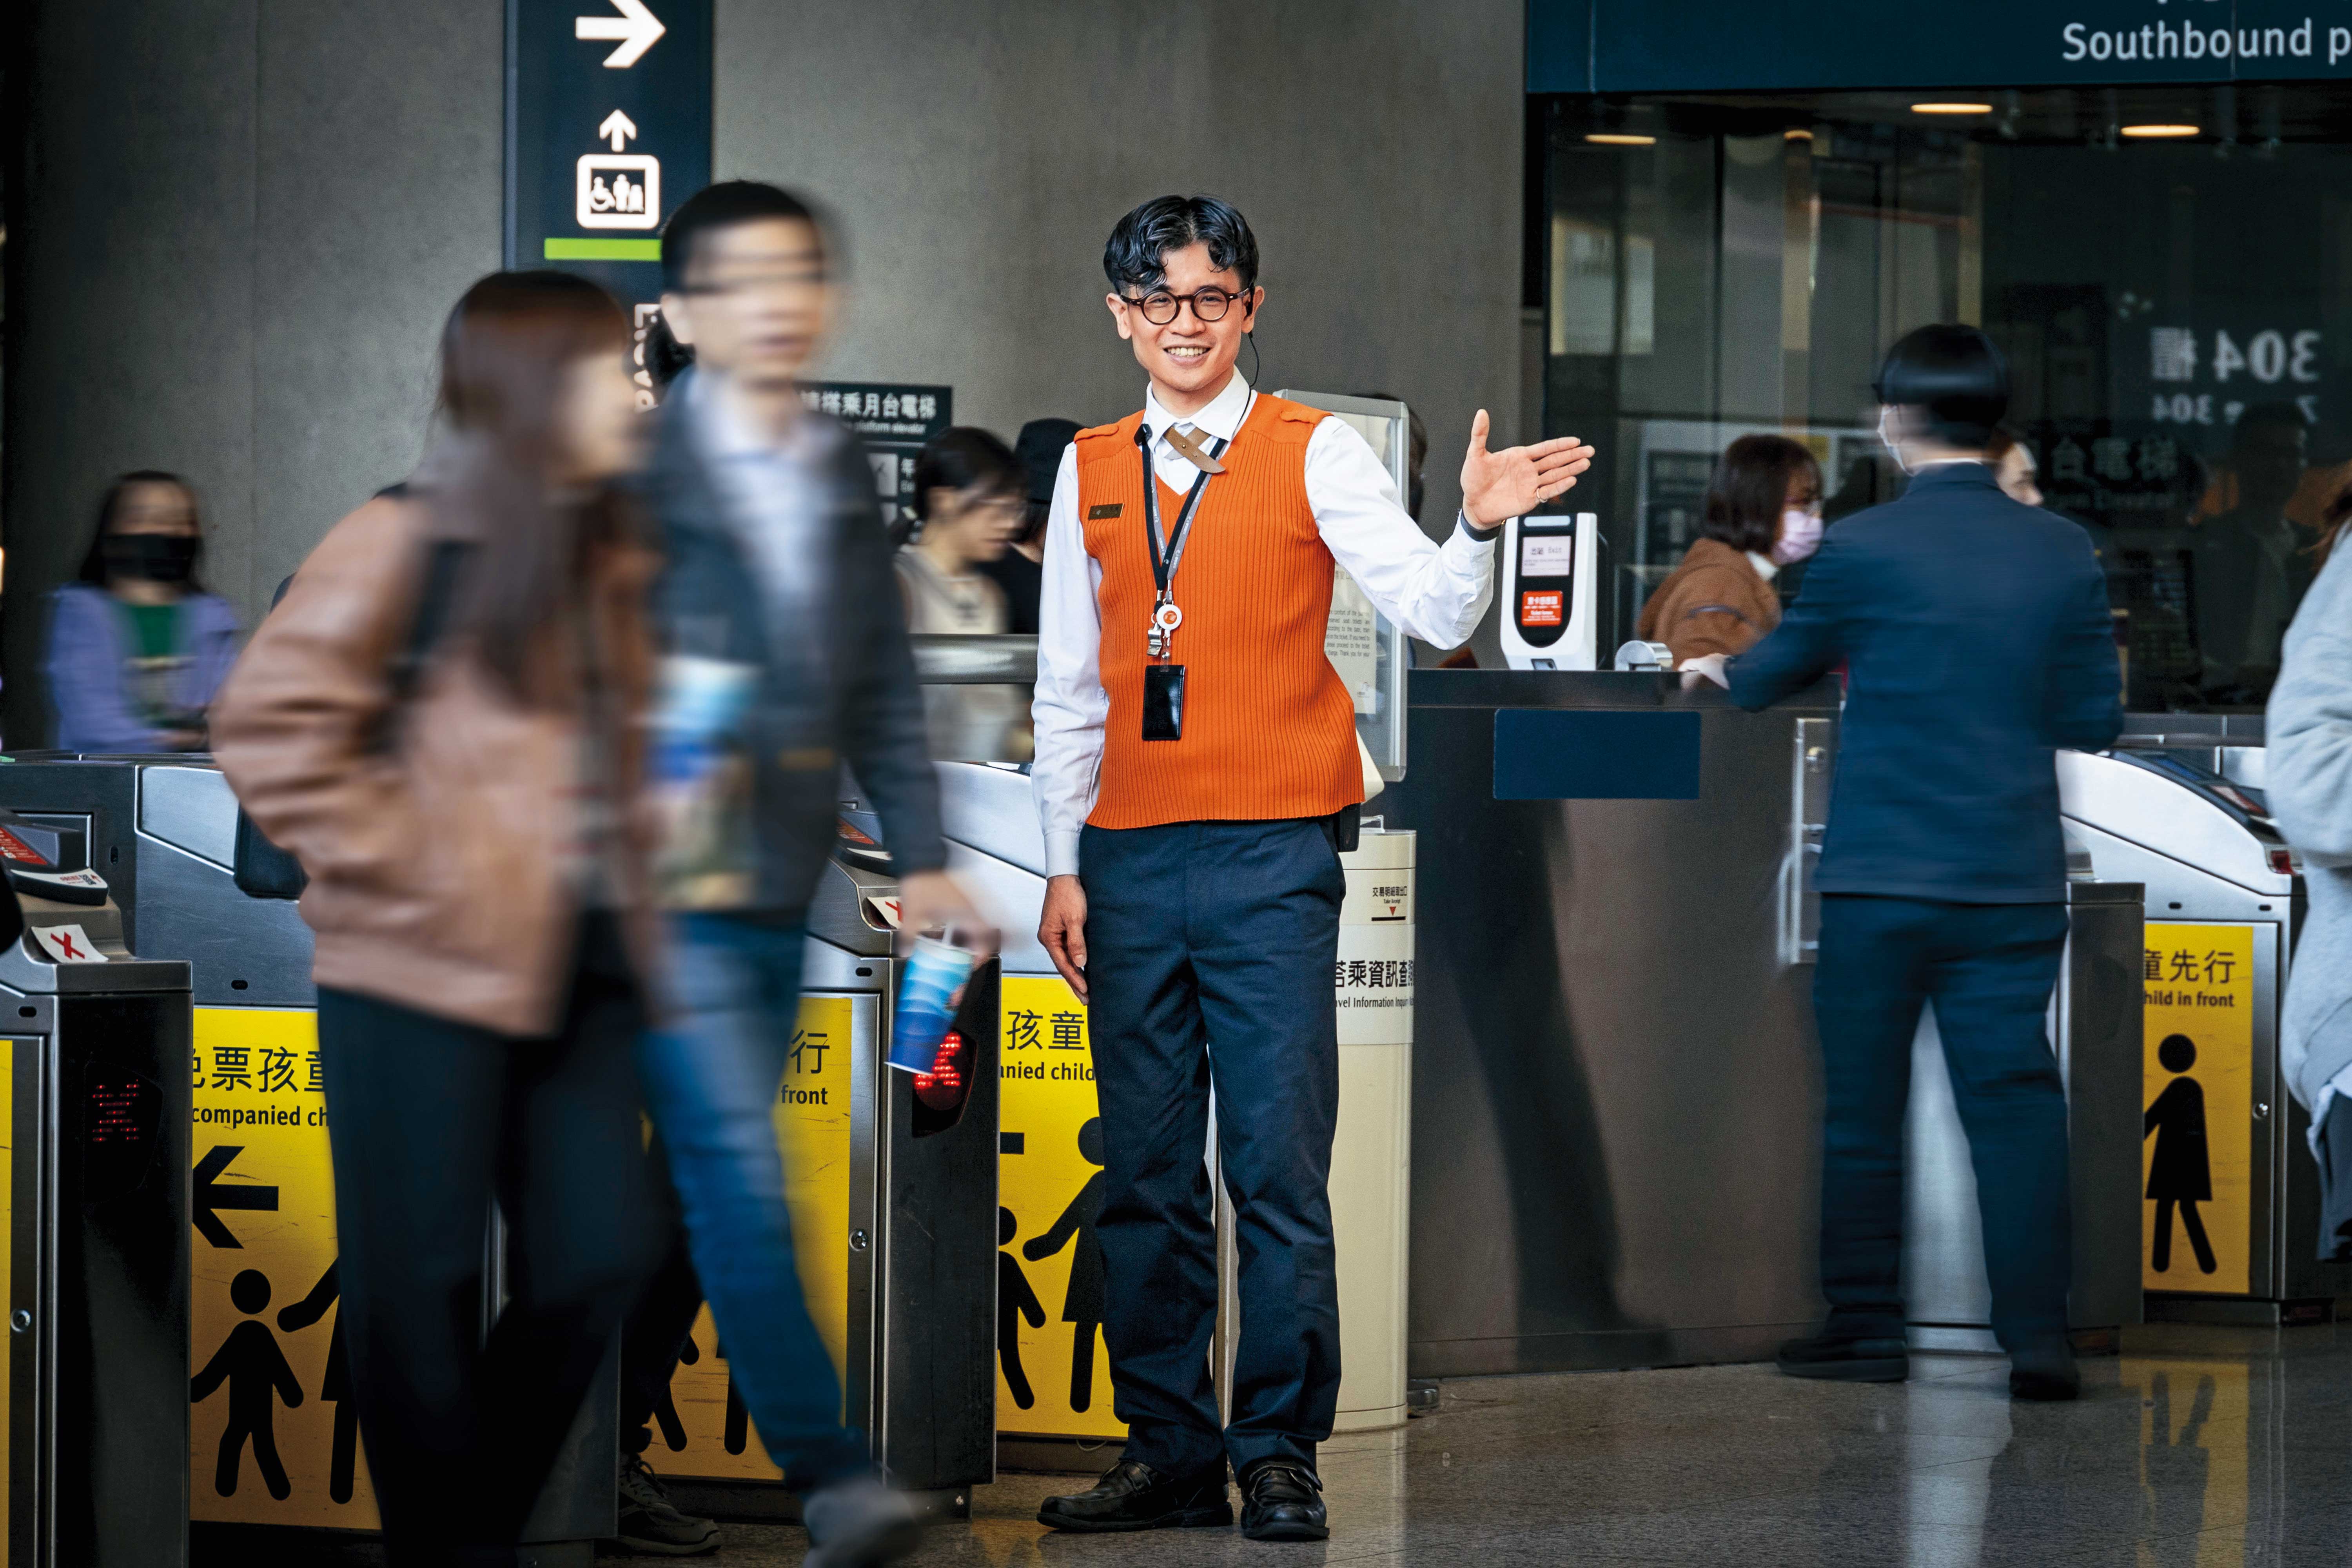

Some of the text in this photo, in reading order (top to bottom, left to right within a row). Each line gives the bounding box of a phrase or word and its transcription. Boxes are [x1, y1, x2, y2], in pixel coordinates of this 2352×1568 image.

[2062, 18, 2312, 61] Southbound
[1372, 886, 1407, 897] 交易明細取出口
[1354, 996, 1394, 1007] Information
[2178, 991, 2192, 1006] in
[2196, 991, 2234, 1007] front
[1006, 1009, 1085, 1050] 孩童
[789, 1029, 830, 1074] 行
[781, 1085, 828, 1105] front
